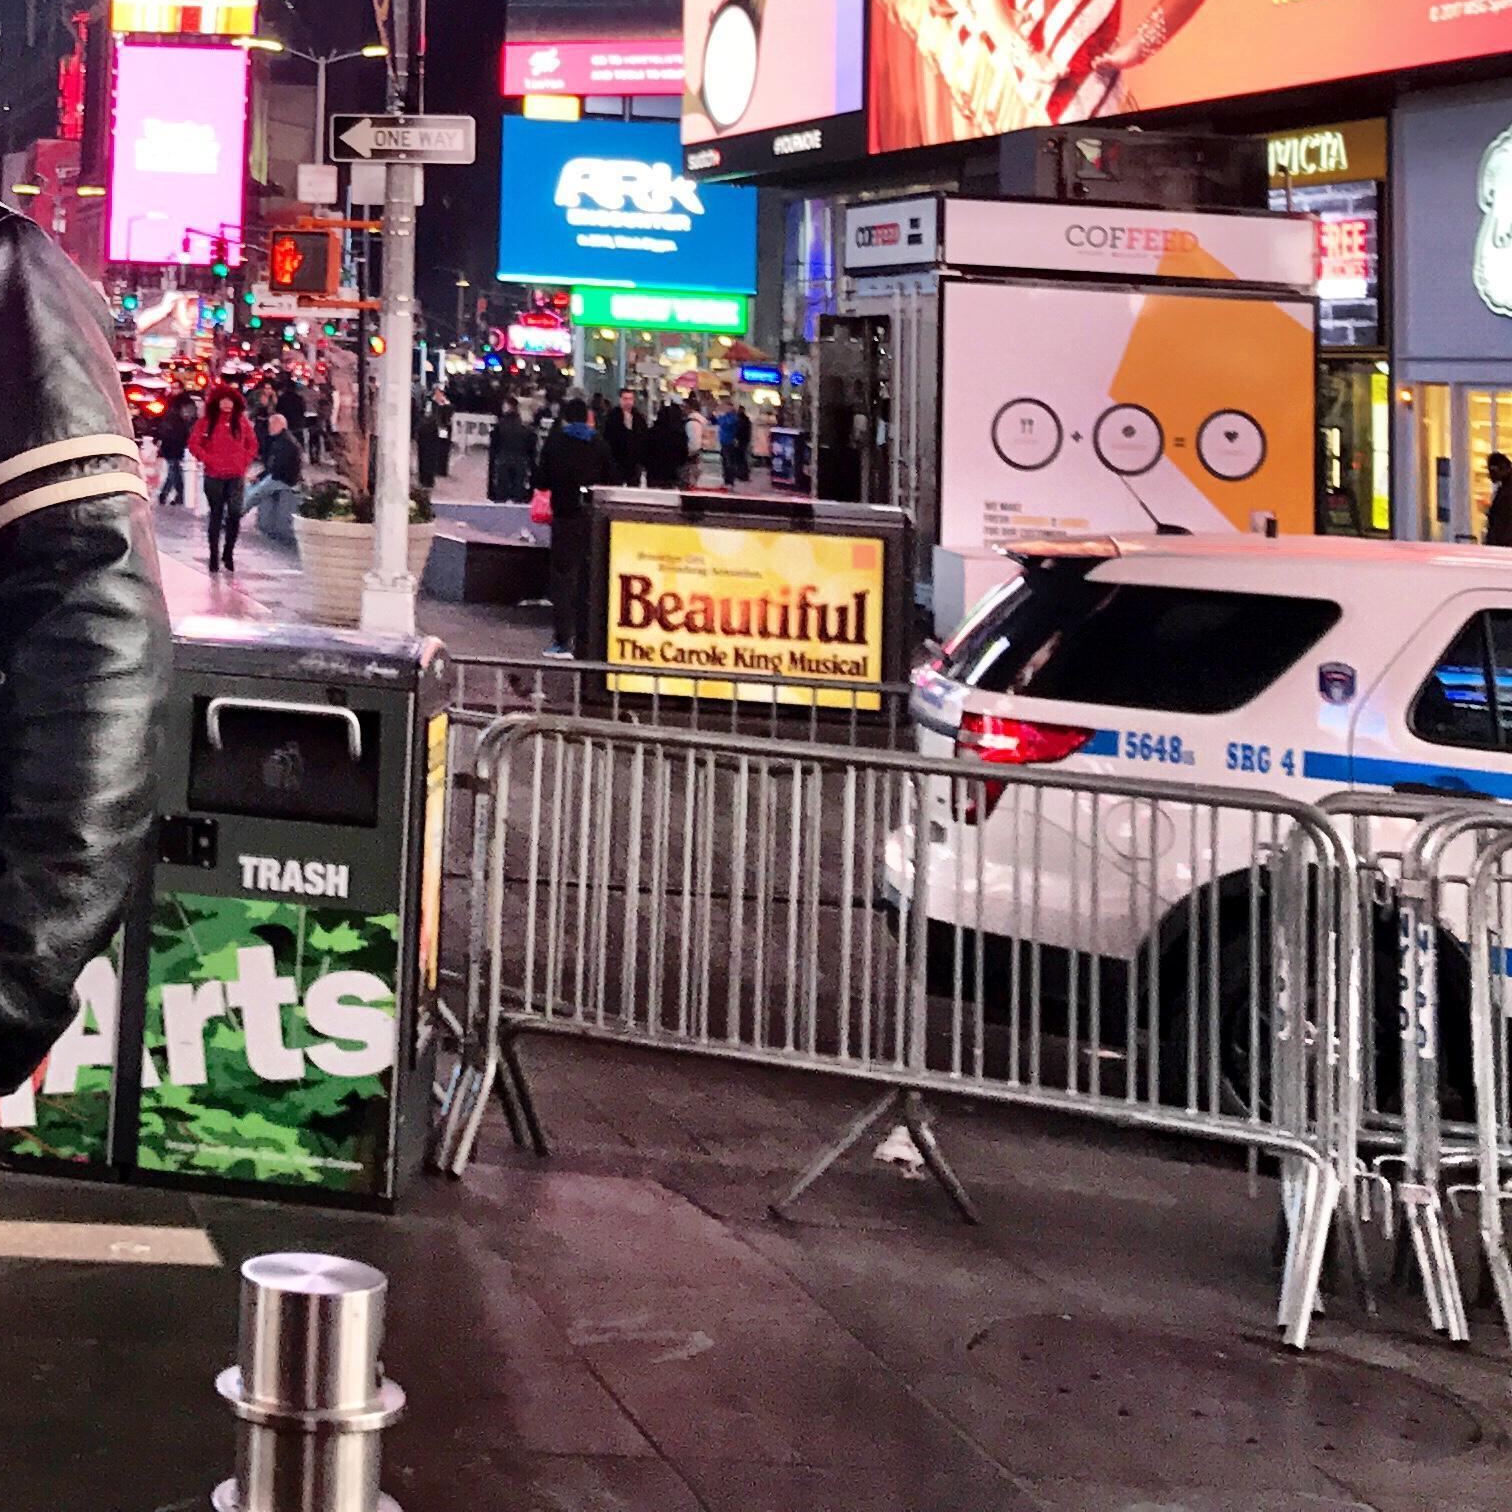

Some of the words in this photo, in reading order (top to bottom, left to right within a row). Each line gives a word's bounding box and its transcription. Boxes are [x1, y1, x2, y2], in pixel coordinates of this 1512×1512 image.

[374, 130, 412, 148] ONE
[419, 131, 461, 149] WAY
[1064, 223, 1200, 253] COFFEED
[617, 574, 871, 646] Beautiful
[616, 638, 653, 662] The
[659, 641, 729, 666] Carole
[733, 647, 784, 675] King
[788, 651, 869, 678] Musical
[1124, 731, 1183, 764] 5648
[1280, 748, 1295, 777] 4
[237, 855, 350, 899] TRASH
[43, 944, 398, 1095] Arts
